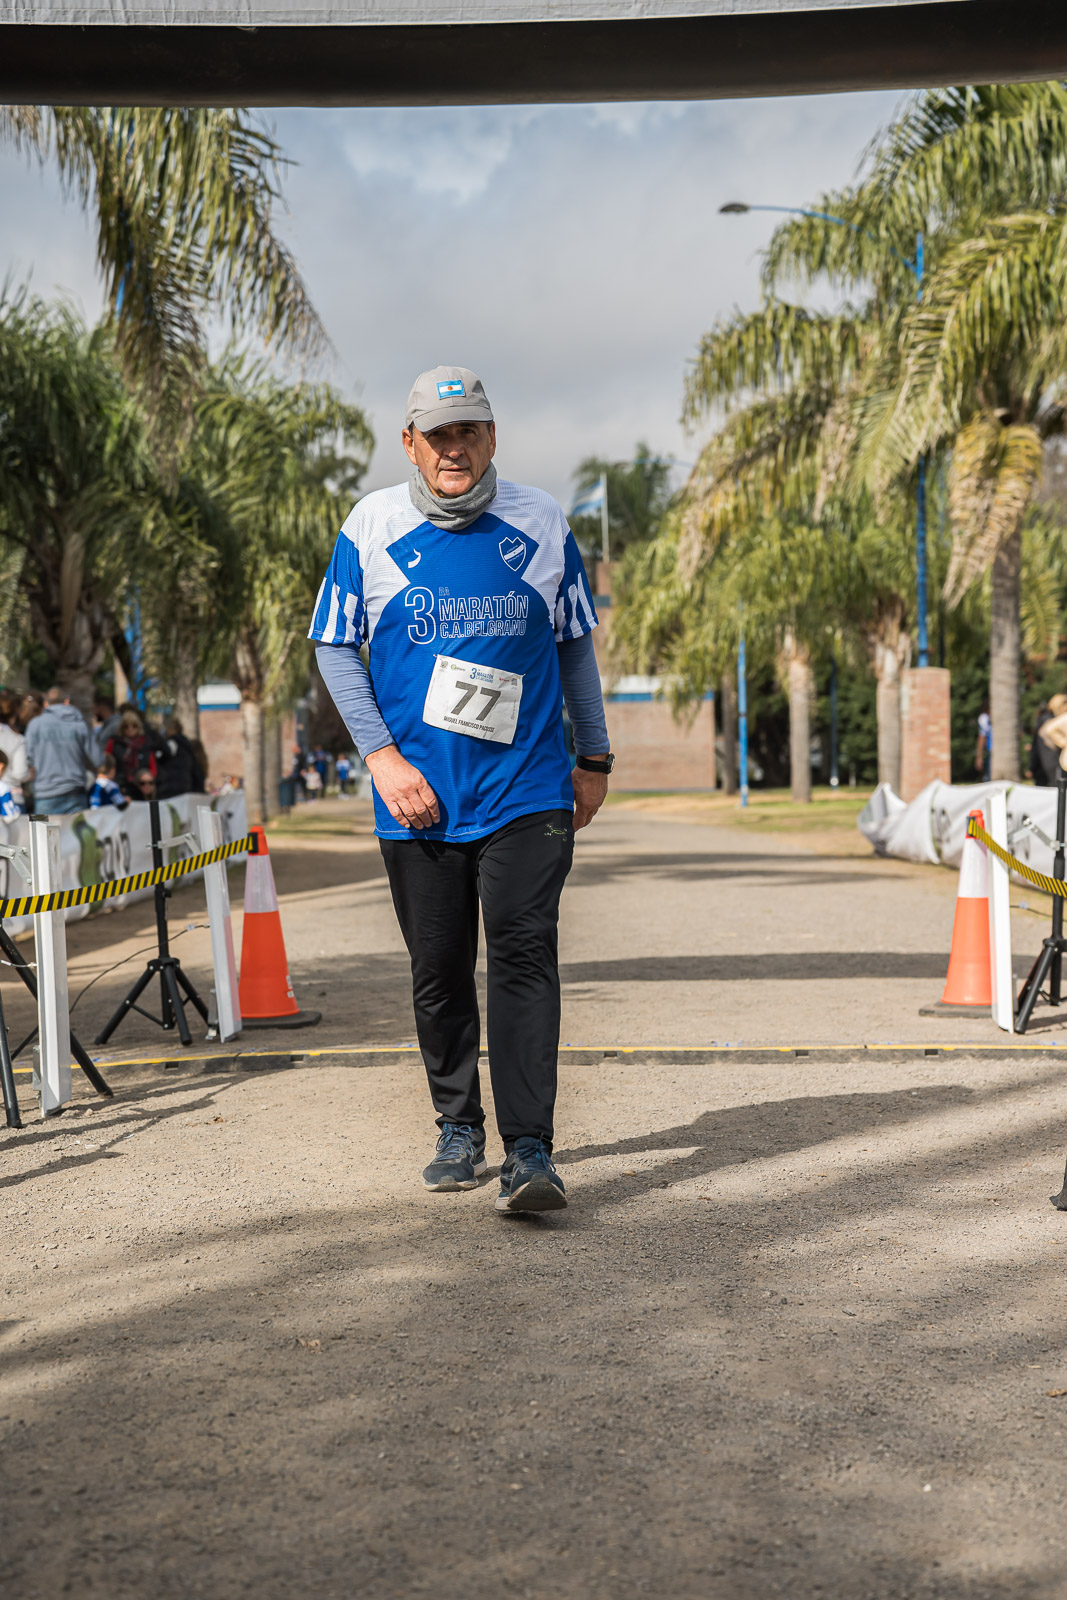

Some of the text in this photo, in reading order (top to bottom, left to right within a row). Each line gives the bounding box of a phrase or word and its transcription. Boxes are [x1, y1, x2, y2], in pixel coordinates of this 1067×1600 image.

[405, 586, 436, 645] 3
[438, 590, 529, 622] MARATÓN
[470, 667, 477, 680] 3
[450, 680, 502, 722] 77
[457, 719, 480, 730] FRANCISCO
